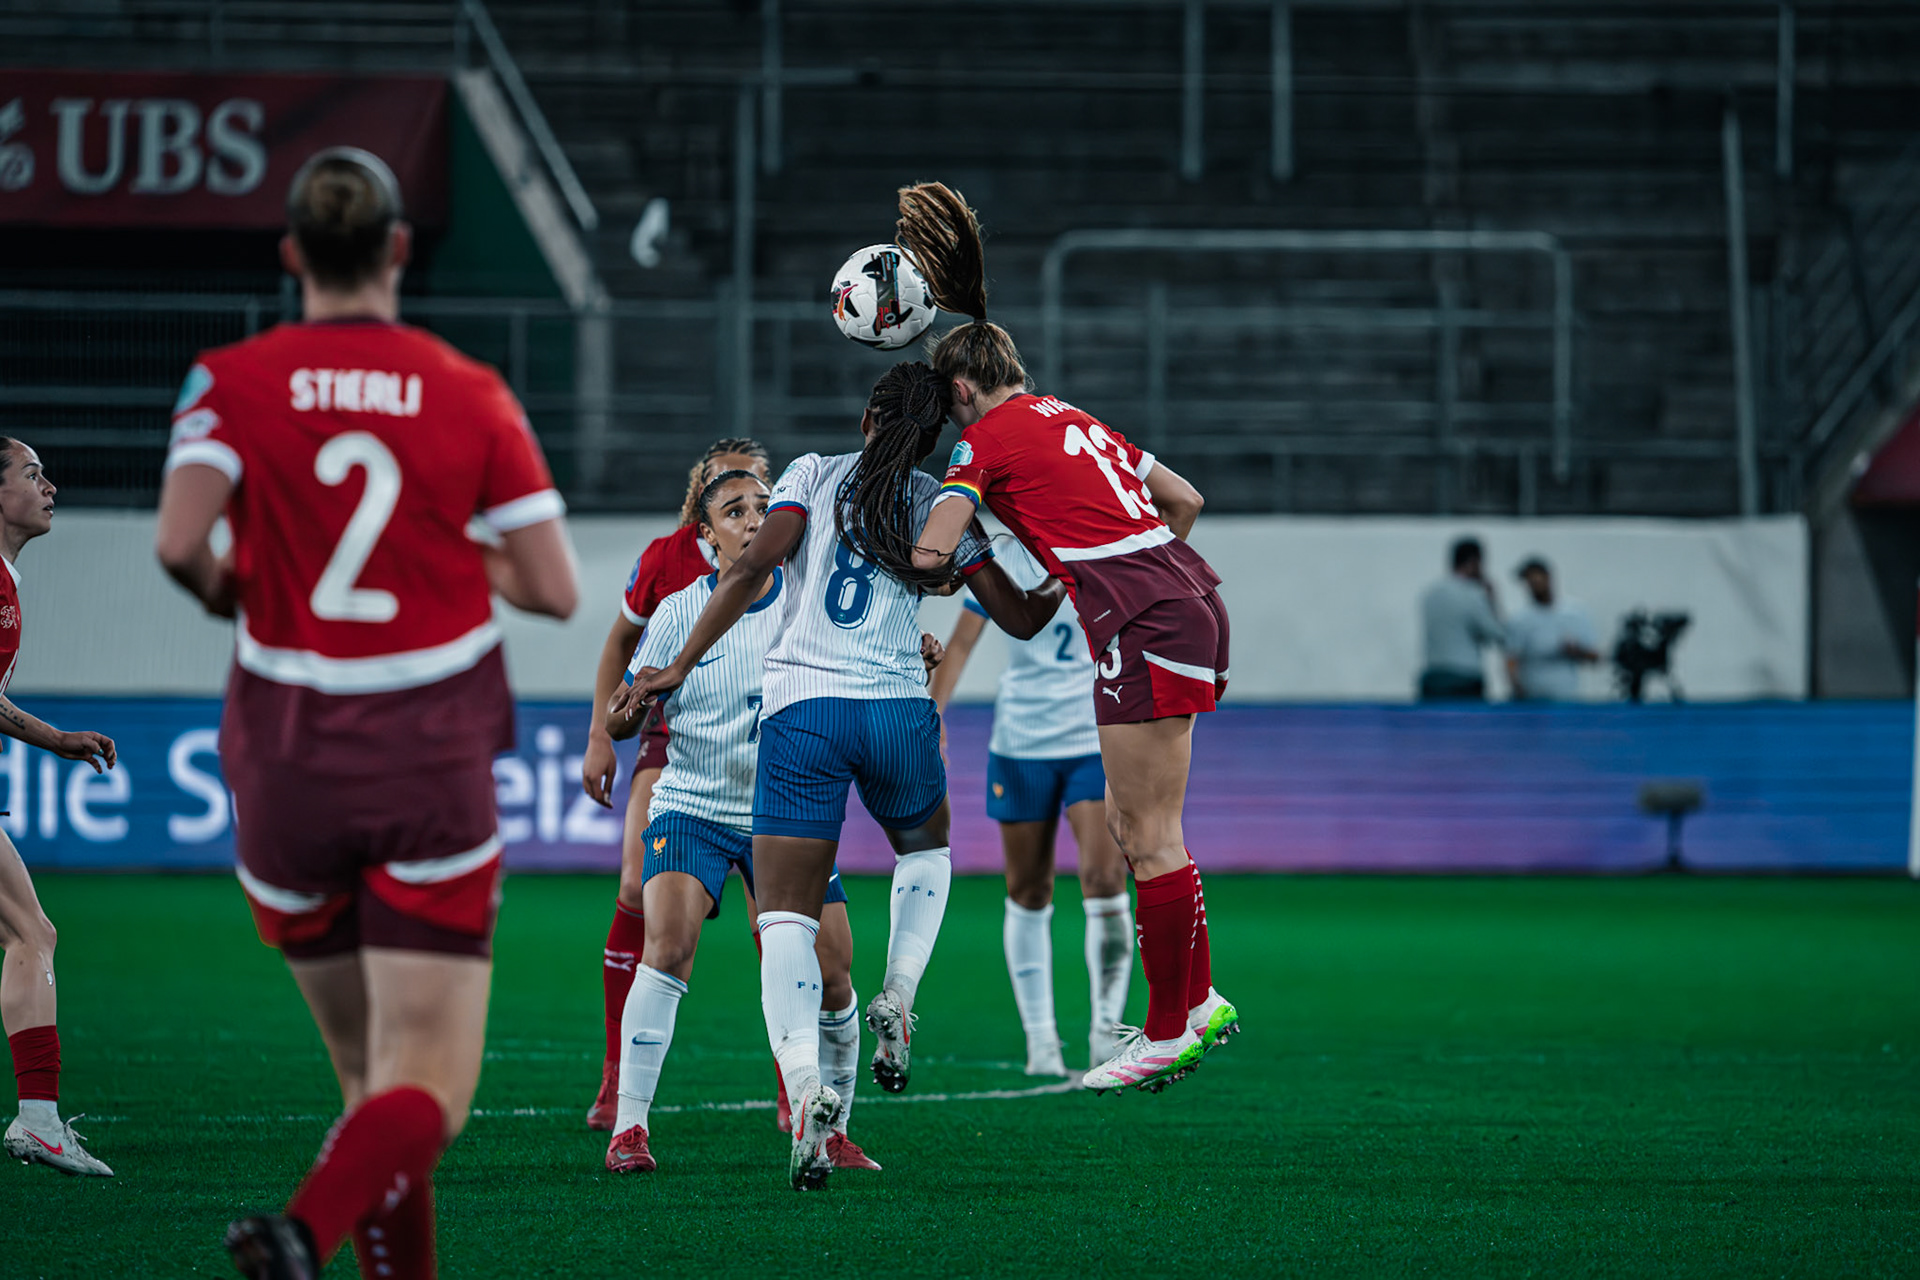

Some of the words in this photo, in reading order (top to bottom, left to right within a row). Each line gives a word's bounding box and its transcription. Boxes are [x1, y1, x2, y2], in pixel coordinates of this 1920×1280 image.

[51, 97, 267, 195] UBS
[289, 367, 422, 418] STIERLI
[1063, 423, 1159, 520] 13
[309, 430, 402, 625] 2
[825, 526, 880, 630] 8
[1054, 622, 1074, 662] 2
[1095, 632, 1122, 680] 3
[747, 694, 763, 744] 7
[168, 724, 622, 844] Seiz
